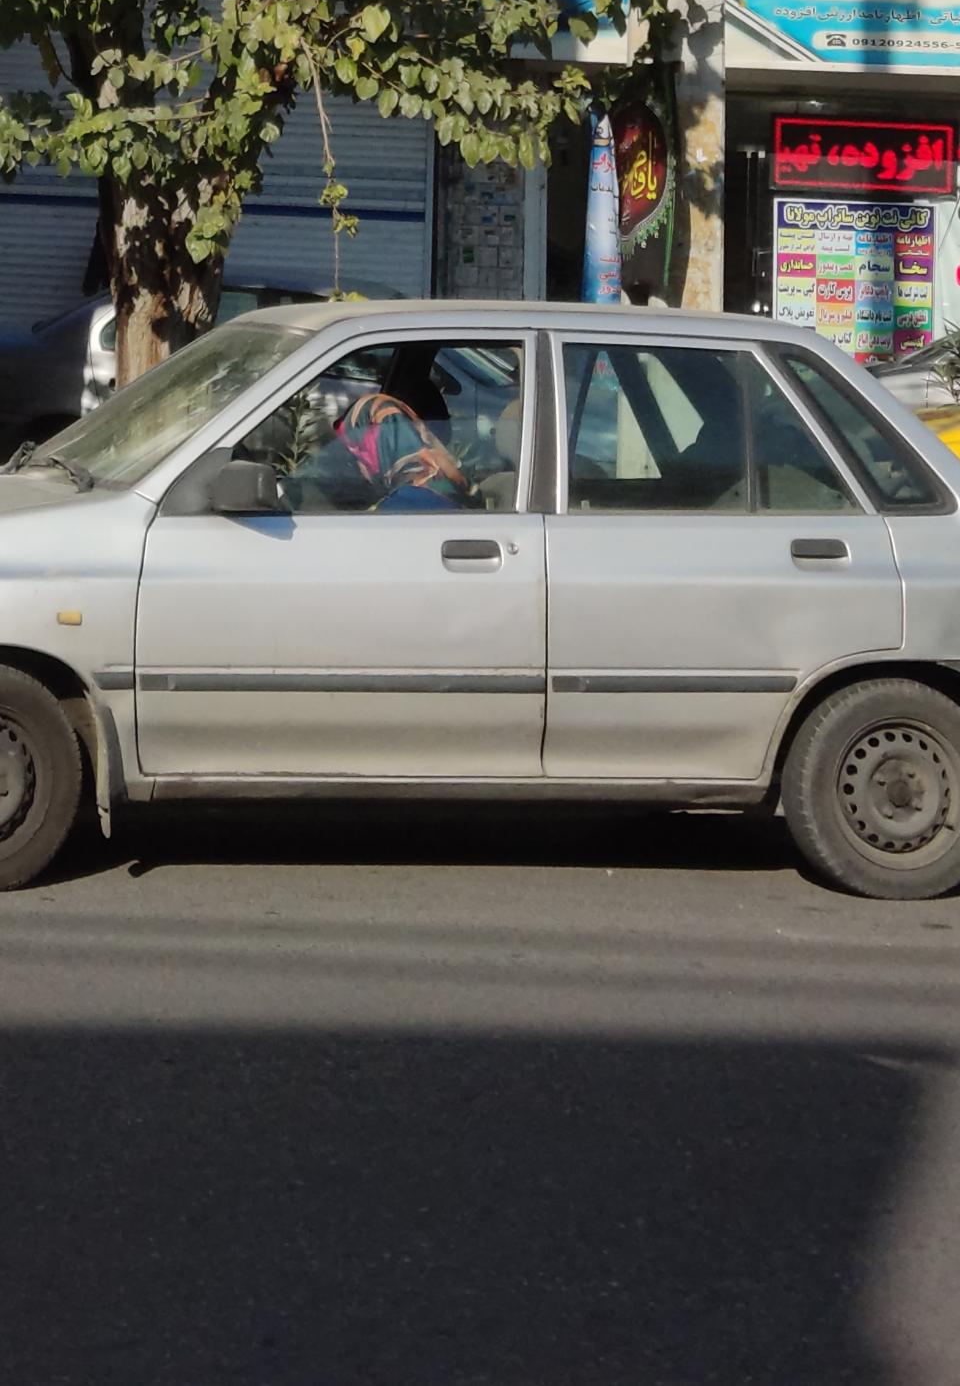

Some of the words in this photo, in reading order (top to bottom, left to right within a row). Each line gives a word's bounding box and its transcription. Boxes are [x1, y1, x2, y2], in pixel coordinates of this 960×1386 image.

[785, 204, 816, 228] مولانا
[816, 205, 854, 229] ساتراپ
[855, 208, 881, 229] نوین
[899, 208, 930, 230] کافی
